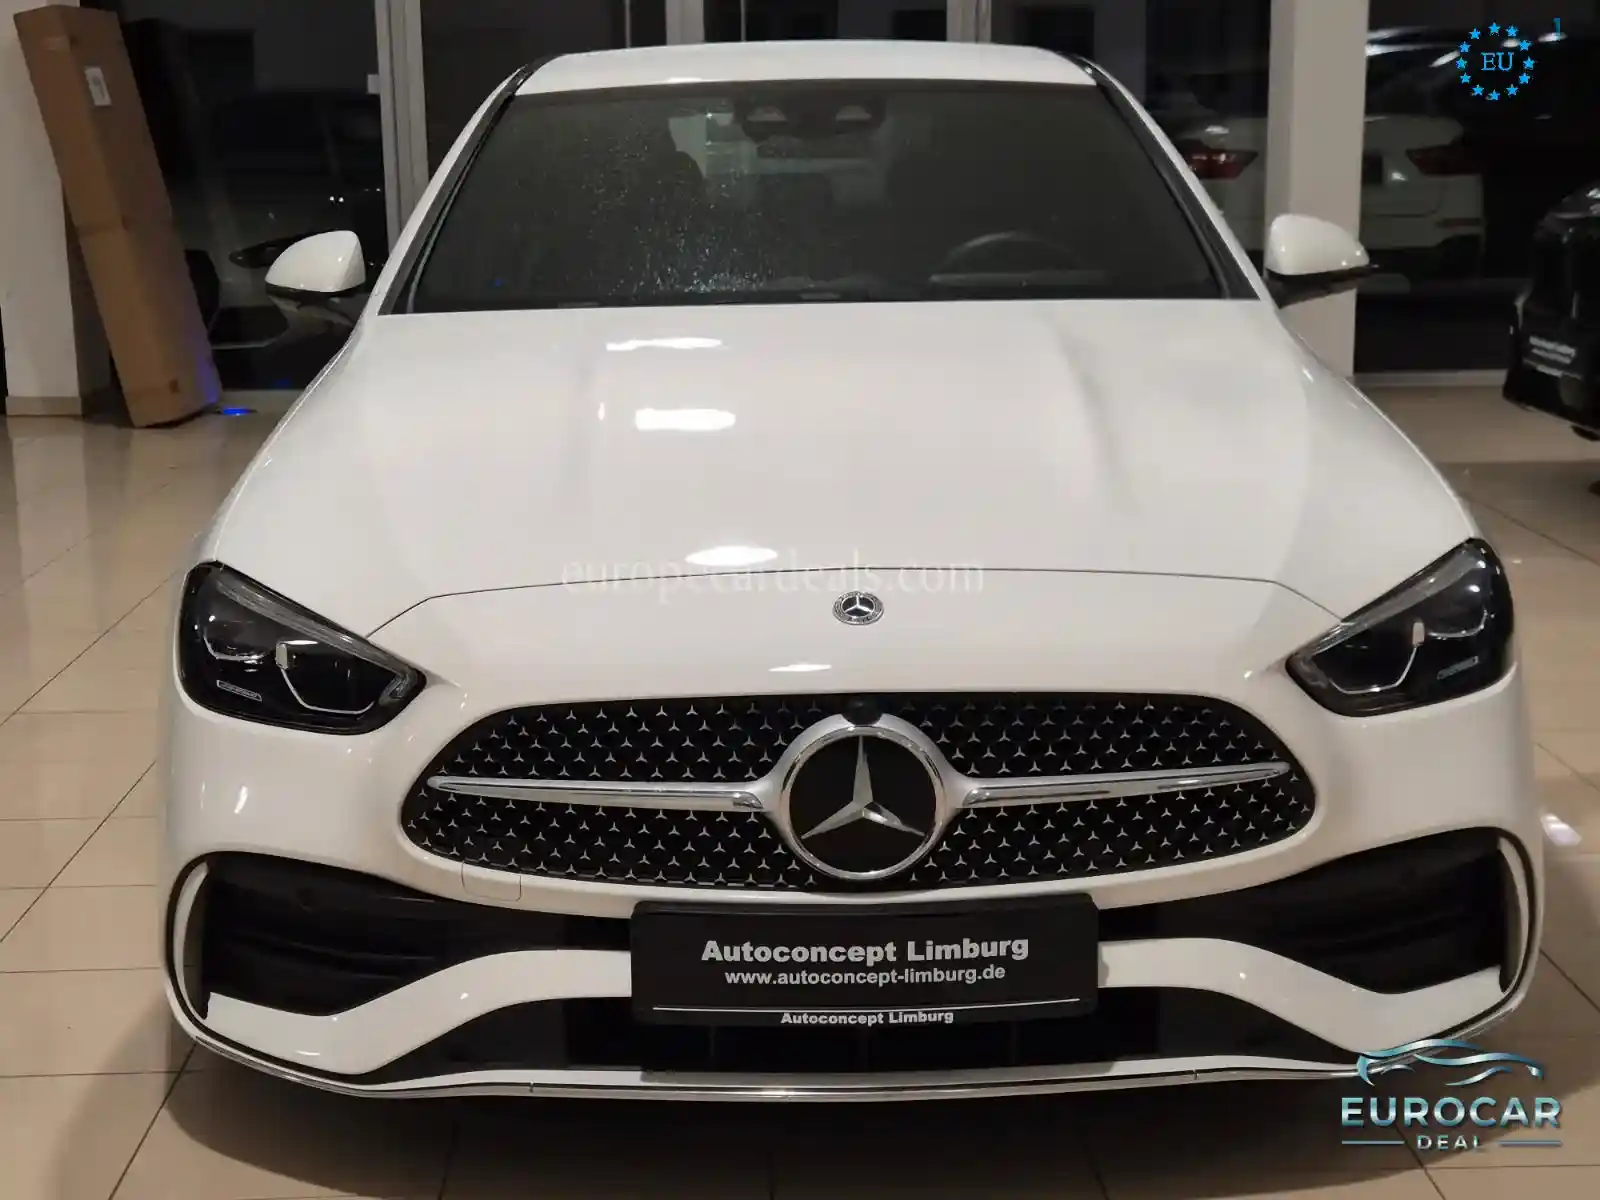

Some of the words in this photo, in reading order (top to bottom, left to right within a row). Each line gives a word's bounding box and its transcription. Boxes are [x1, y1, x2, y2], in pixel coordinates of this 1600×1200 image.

[701, 940, 896, 967] Autoconcept
[908, 938, 1029, 962] Limburg
[725, 965, 1006, 987] www.autoconcept-limburg.de
[780, 1012, 884, 1027] Autoconcept
[889, 1010, 954, 1025] Limburg
